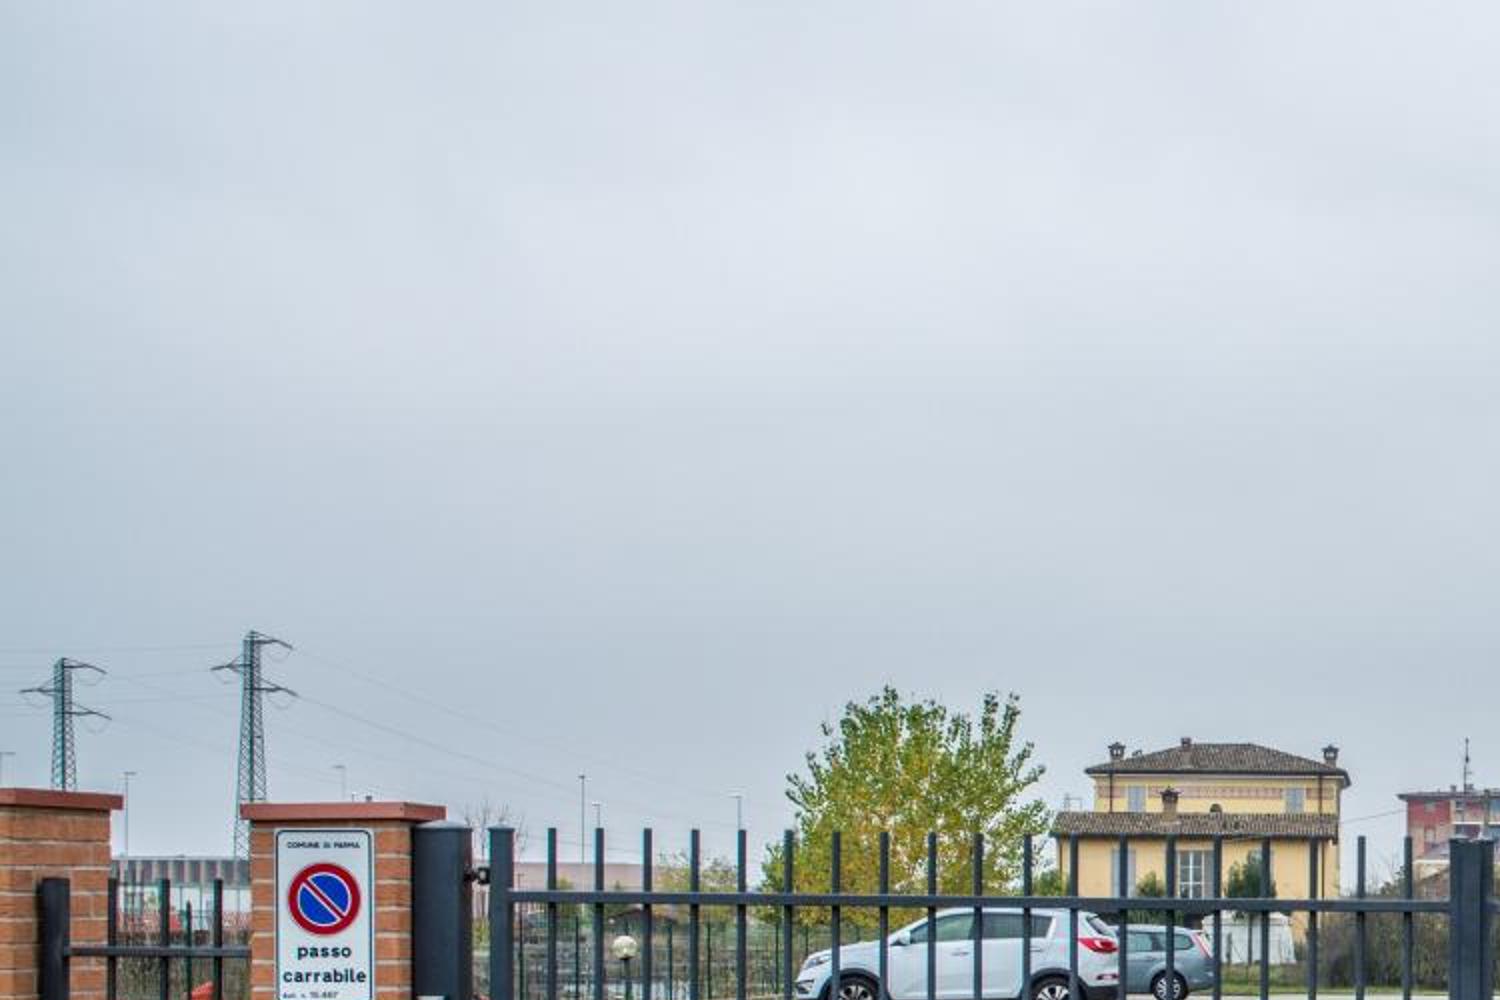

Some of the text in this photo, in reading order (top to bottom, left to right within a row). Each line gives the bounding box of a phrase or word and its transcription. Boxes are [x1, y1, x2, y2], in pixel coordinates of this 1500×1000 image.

[287, 841, 320, 849] COMUNE
[333, 841, 361, 849] PARMA
[297, 946, 352, 960] passo
[283, 968, 367, 983] carrabile
